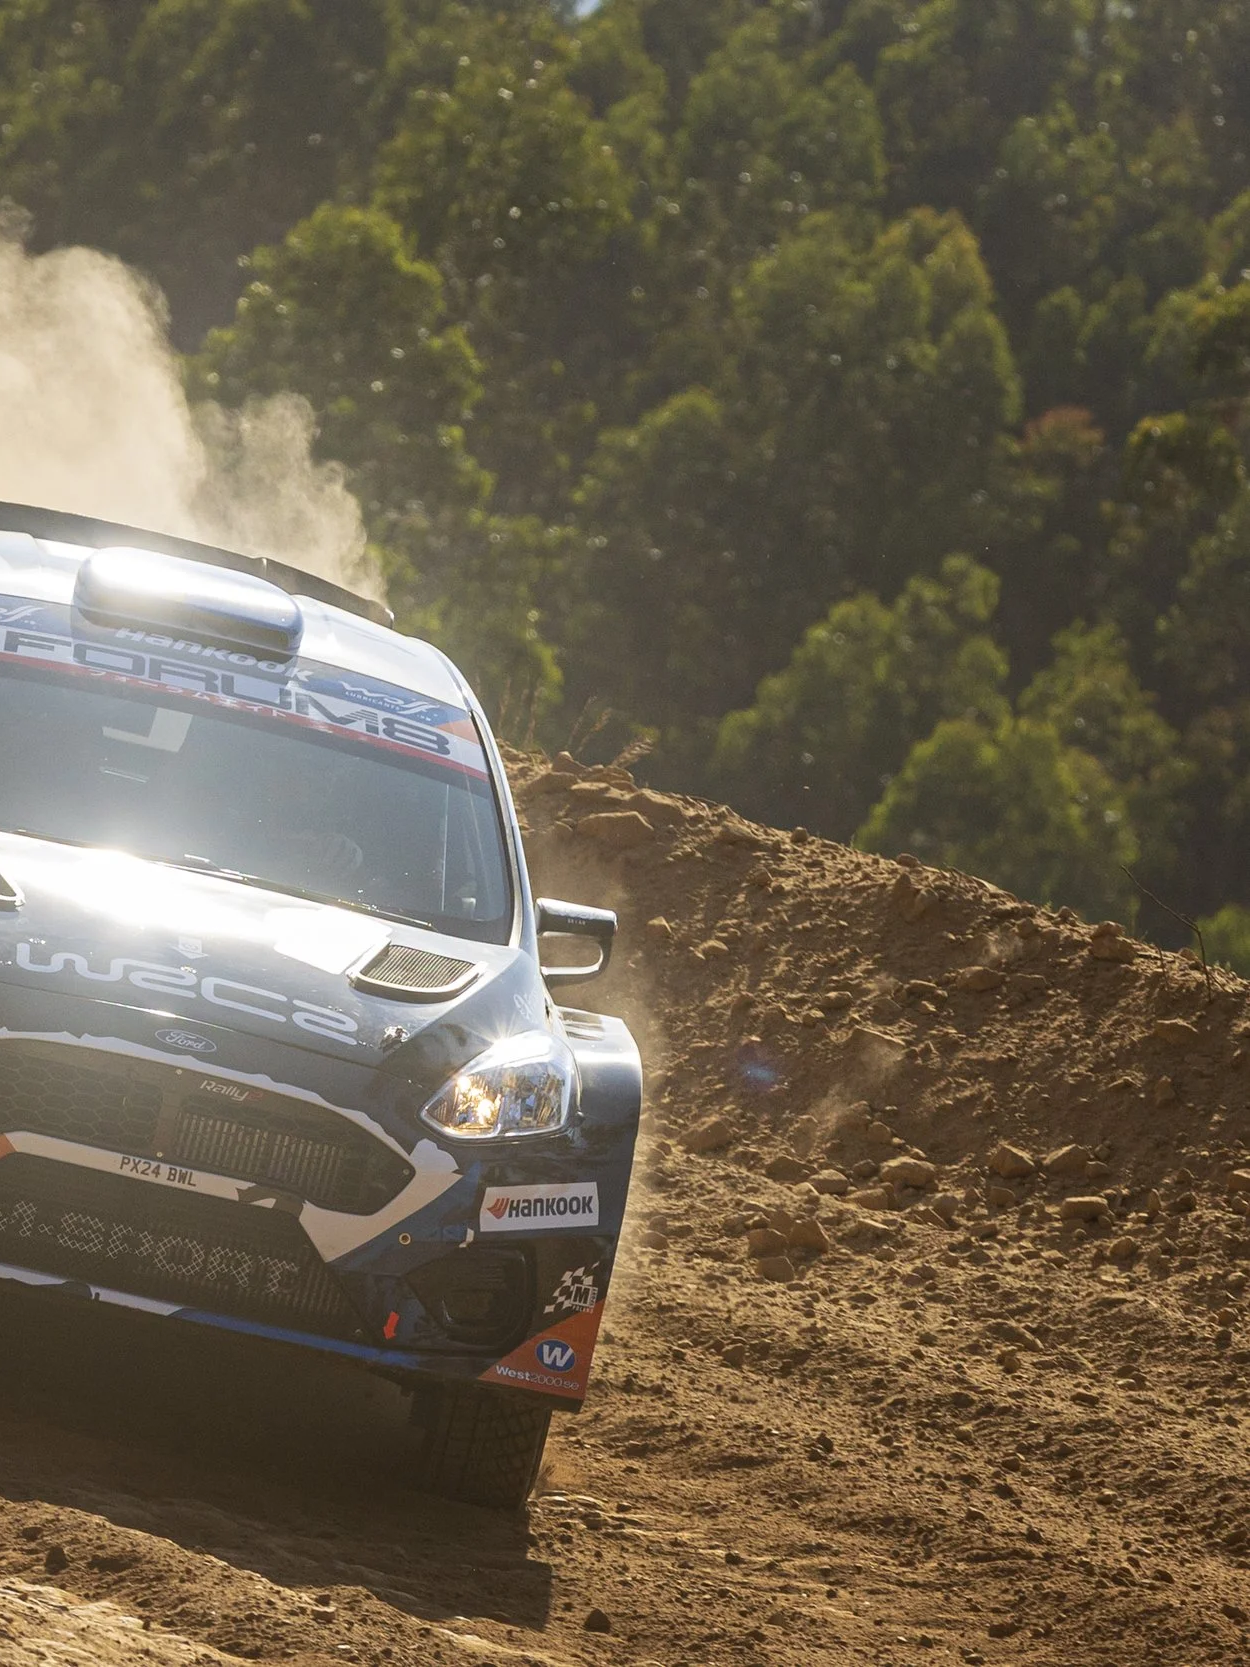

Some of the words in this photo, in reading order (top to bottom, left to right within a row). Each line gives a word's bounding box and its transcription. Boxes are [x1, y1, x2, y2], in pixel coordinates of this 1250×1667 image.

[3, 630, 451, 756] FORUM8
[165, 1030, 207, 1050] Ford
[119, 1156, 162, 1178] PX24
[166, 1167, 198, 1187] BWL
[542, 1344, 573, 1367] W
